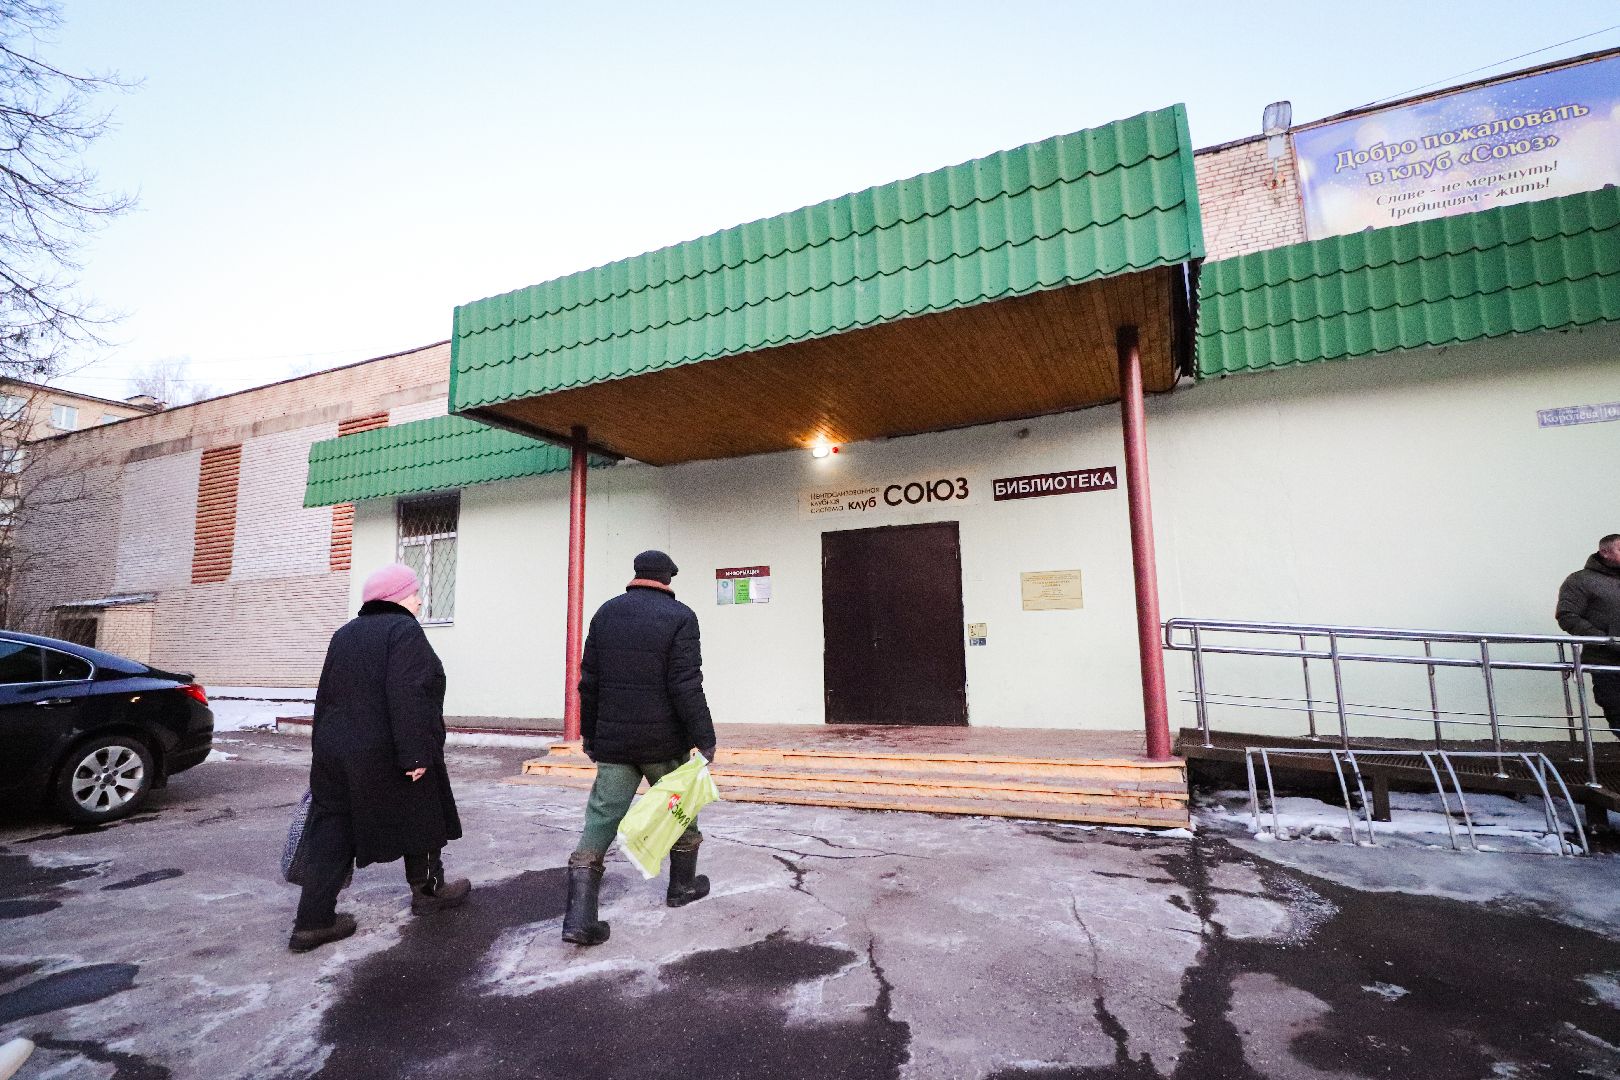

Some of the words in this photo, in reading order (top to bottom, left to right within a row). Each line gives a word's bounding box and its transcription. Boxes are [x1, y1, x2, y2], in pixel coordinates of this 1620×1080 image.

[1335, 140, 1417, 173] Добро
[1422, 104, 1590, 149] пожаловать
[1366, 171, 1384, 185] в
[1388, 151, 1453, 181] клуб
[1458, 134, 1559, 165] «Союз»
[1376, 190, 1425, 206] Славе
[1442, 182, 1460, 193] не
[1465, 160, 1558, 187] меркнуть!
[1389, 193, 1478, 219] Традициям
[1496, 177, 1549, 198] жить!
[848, 496, 877, 511] клуб
[883, 477, 969, 506] СОЮЗ
[995, 472, 1115, 496] БИБЛИОТЕКА
